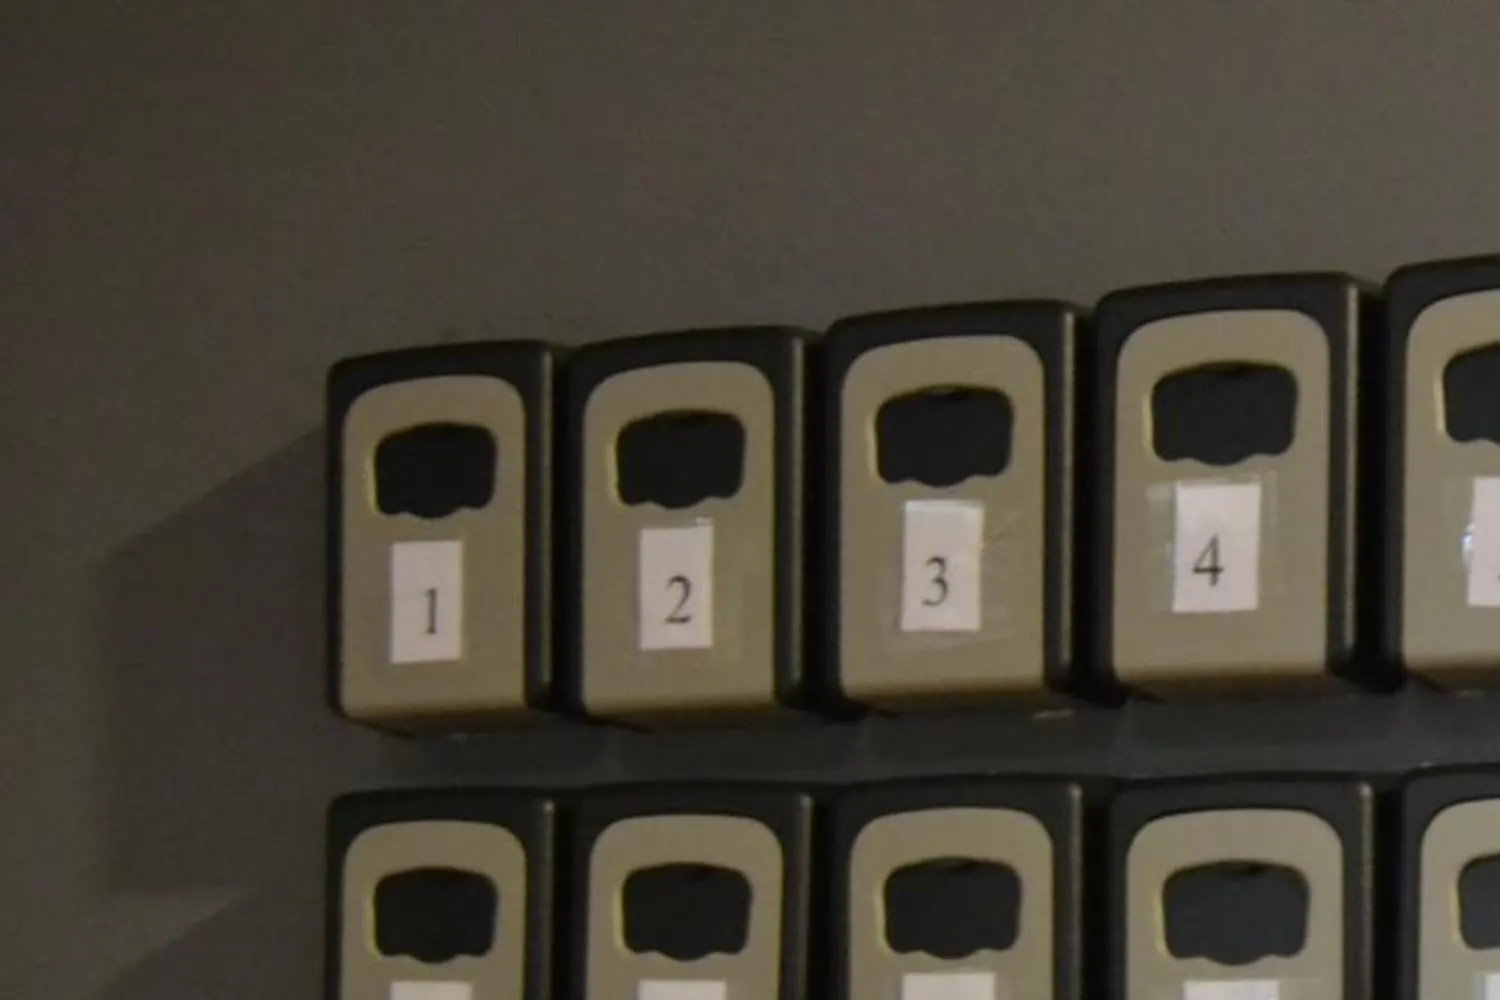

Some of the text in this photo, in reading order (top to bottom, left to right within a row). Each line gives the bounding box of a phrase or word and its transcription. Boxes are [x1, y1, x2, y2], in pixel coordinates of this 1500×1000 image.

[922, 555, 949, 607] 3
[1192, 532, 1224, 587] 4
[422, 586, 439, 637] 1
[664, 574, 692, 625] 2
